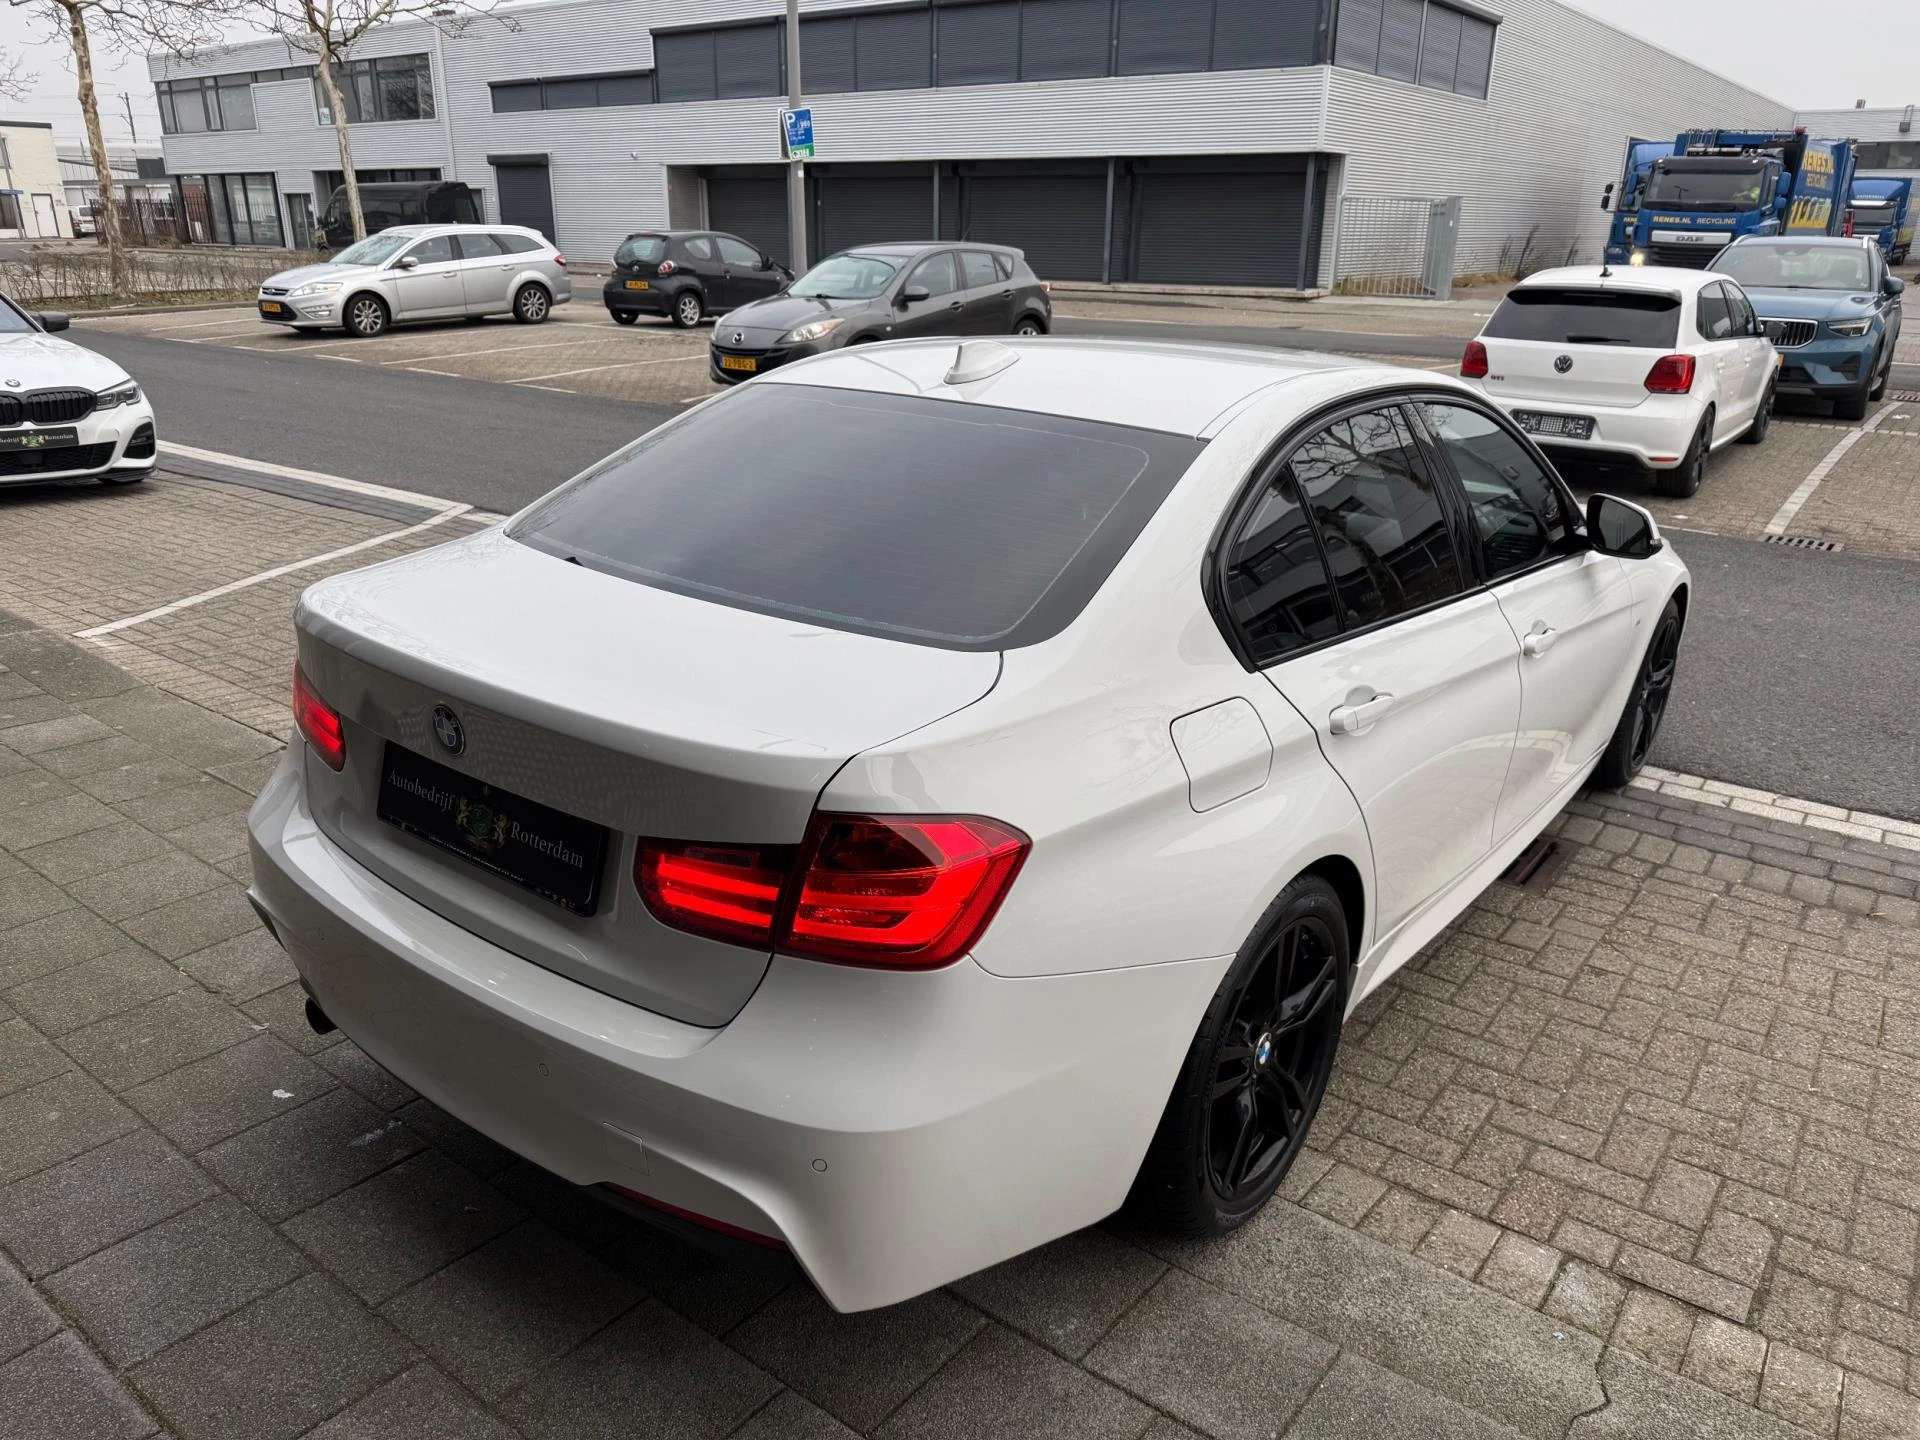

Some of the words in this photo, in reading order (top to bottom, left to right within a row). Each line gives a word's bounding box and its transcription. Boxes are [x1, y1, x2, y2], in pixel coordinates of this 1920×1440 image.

[785, 112, 796, 129] P
[1653, 216, 1692, 224] RENES.NL
[1696, 217, 1736, 225] RECYCLING
[387, 769, 456, 813] Autobedrijf
[511, 820, 583, 869] Rotterdam
